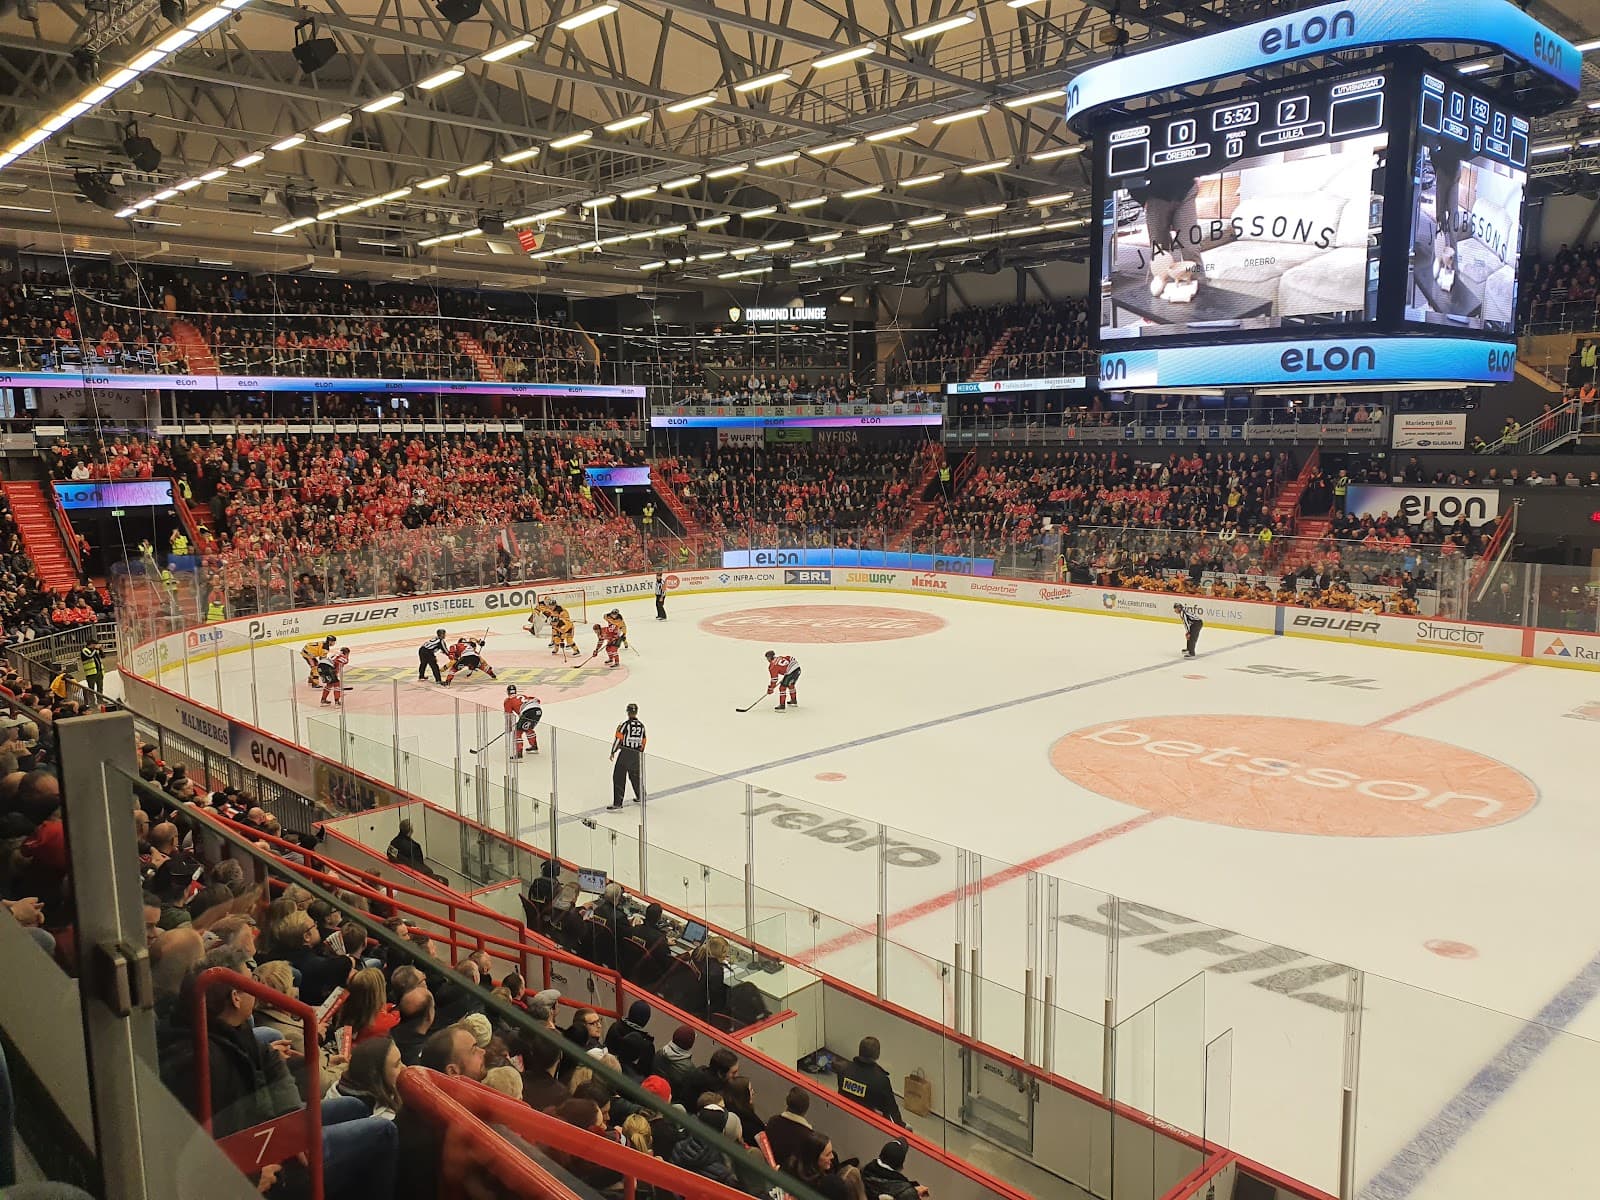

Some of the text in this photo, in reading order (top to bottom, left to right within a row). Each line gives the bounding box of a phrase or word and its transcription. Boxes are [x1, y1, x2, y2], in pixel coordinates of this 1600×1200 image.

[1284, 103, 1296, 121] 2
[1456, 98, 1462, 115] 0
[1223, 107, 1252, 125] 5:52
[1497, 119, 1502, 133] 2
[1178, 127, 1189, 141] 0
[1166, 147, 1196, 161] ÖREBRO
[1231, 141, 1238, 153] 1
[1136, 215, 1336, 270] JAKOBSSONS
[1243, 256, 1276, 268] ÖREBRO
[745, 307, 827, 320] DIAMOND LOUNGE
[818, 431, 858, 443] NYFOSA
[733, 574, 775, 582] INFRA-CON
[799, 571, 829, 581] BRL
[846, 572, 896, 584] SUBWAY
[970, 583, 1018, 594] Budpartner
[322, 607, 399, 626] BAUER
[289, 627, 300, 635] AB
[1292, 614, 1382, 634] BAUER
[1416, 621, 1485, 644] Structor
[1226, 664, 1382, 691] SHL
[181, 710, 229, 745] MALMBERGS
[631, 727, 641, 736] 22
[1078, 724, 1502, 819] betsson
[253, 1127, 276, 1164] 7
